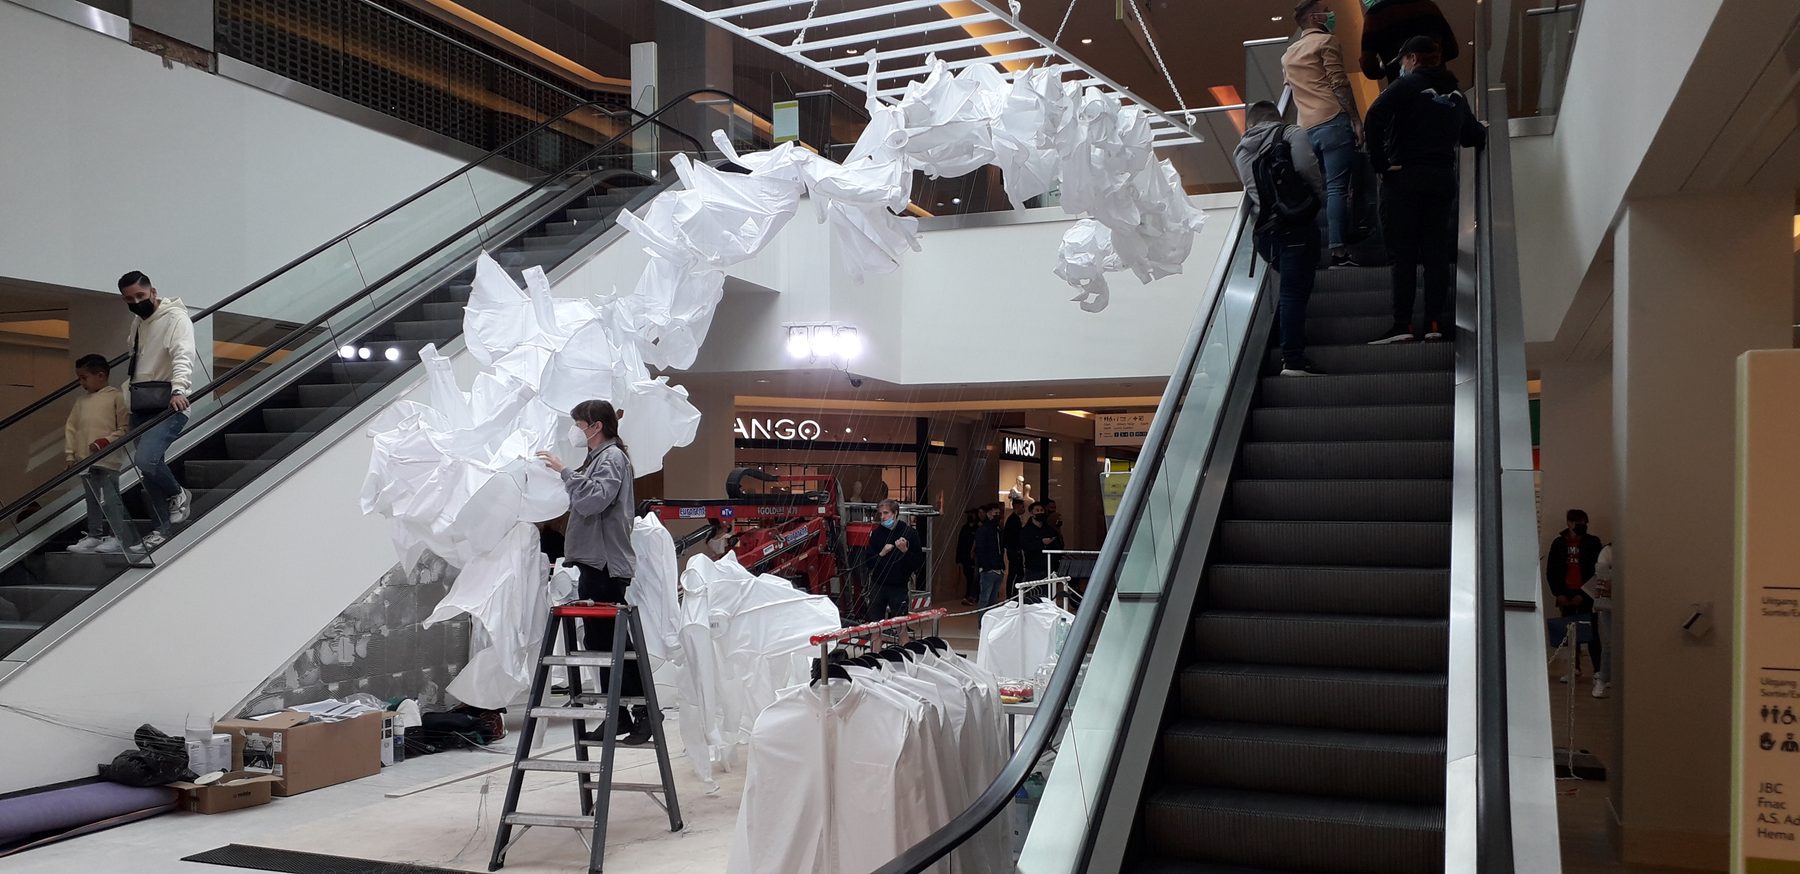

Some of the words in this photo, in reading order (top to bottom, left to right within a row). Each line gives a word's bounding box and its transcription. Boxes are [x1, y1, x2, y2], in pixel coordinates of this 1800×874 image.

[1005, 437, 1036, 457] MANGO
[1759, 783, 1783, 794] JBC
[1758, 797, 1786, 810] Fnac
[1758, 828, 1795, 841] Hema
